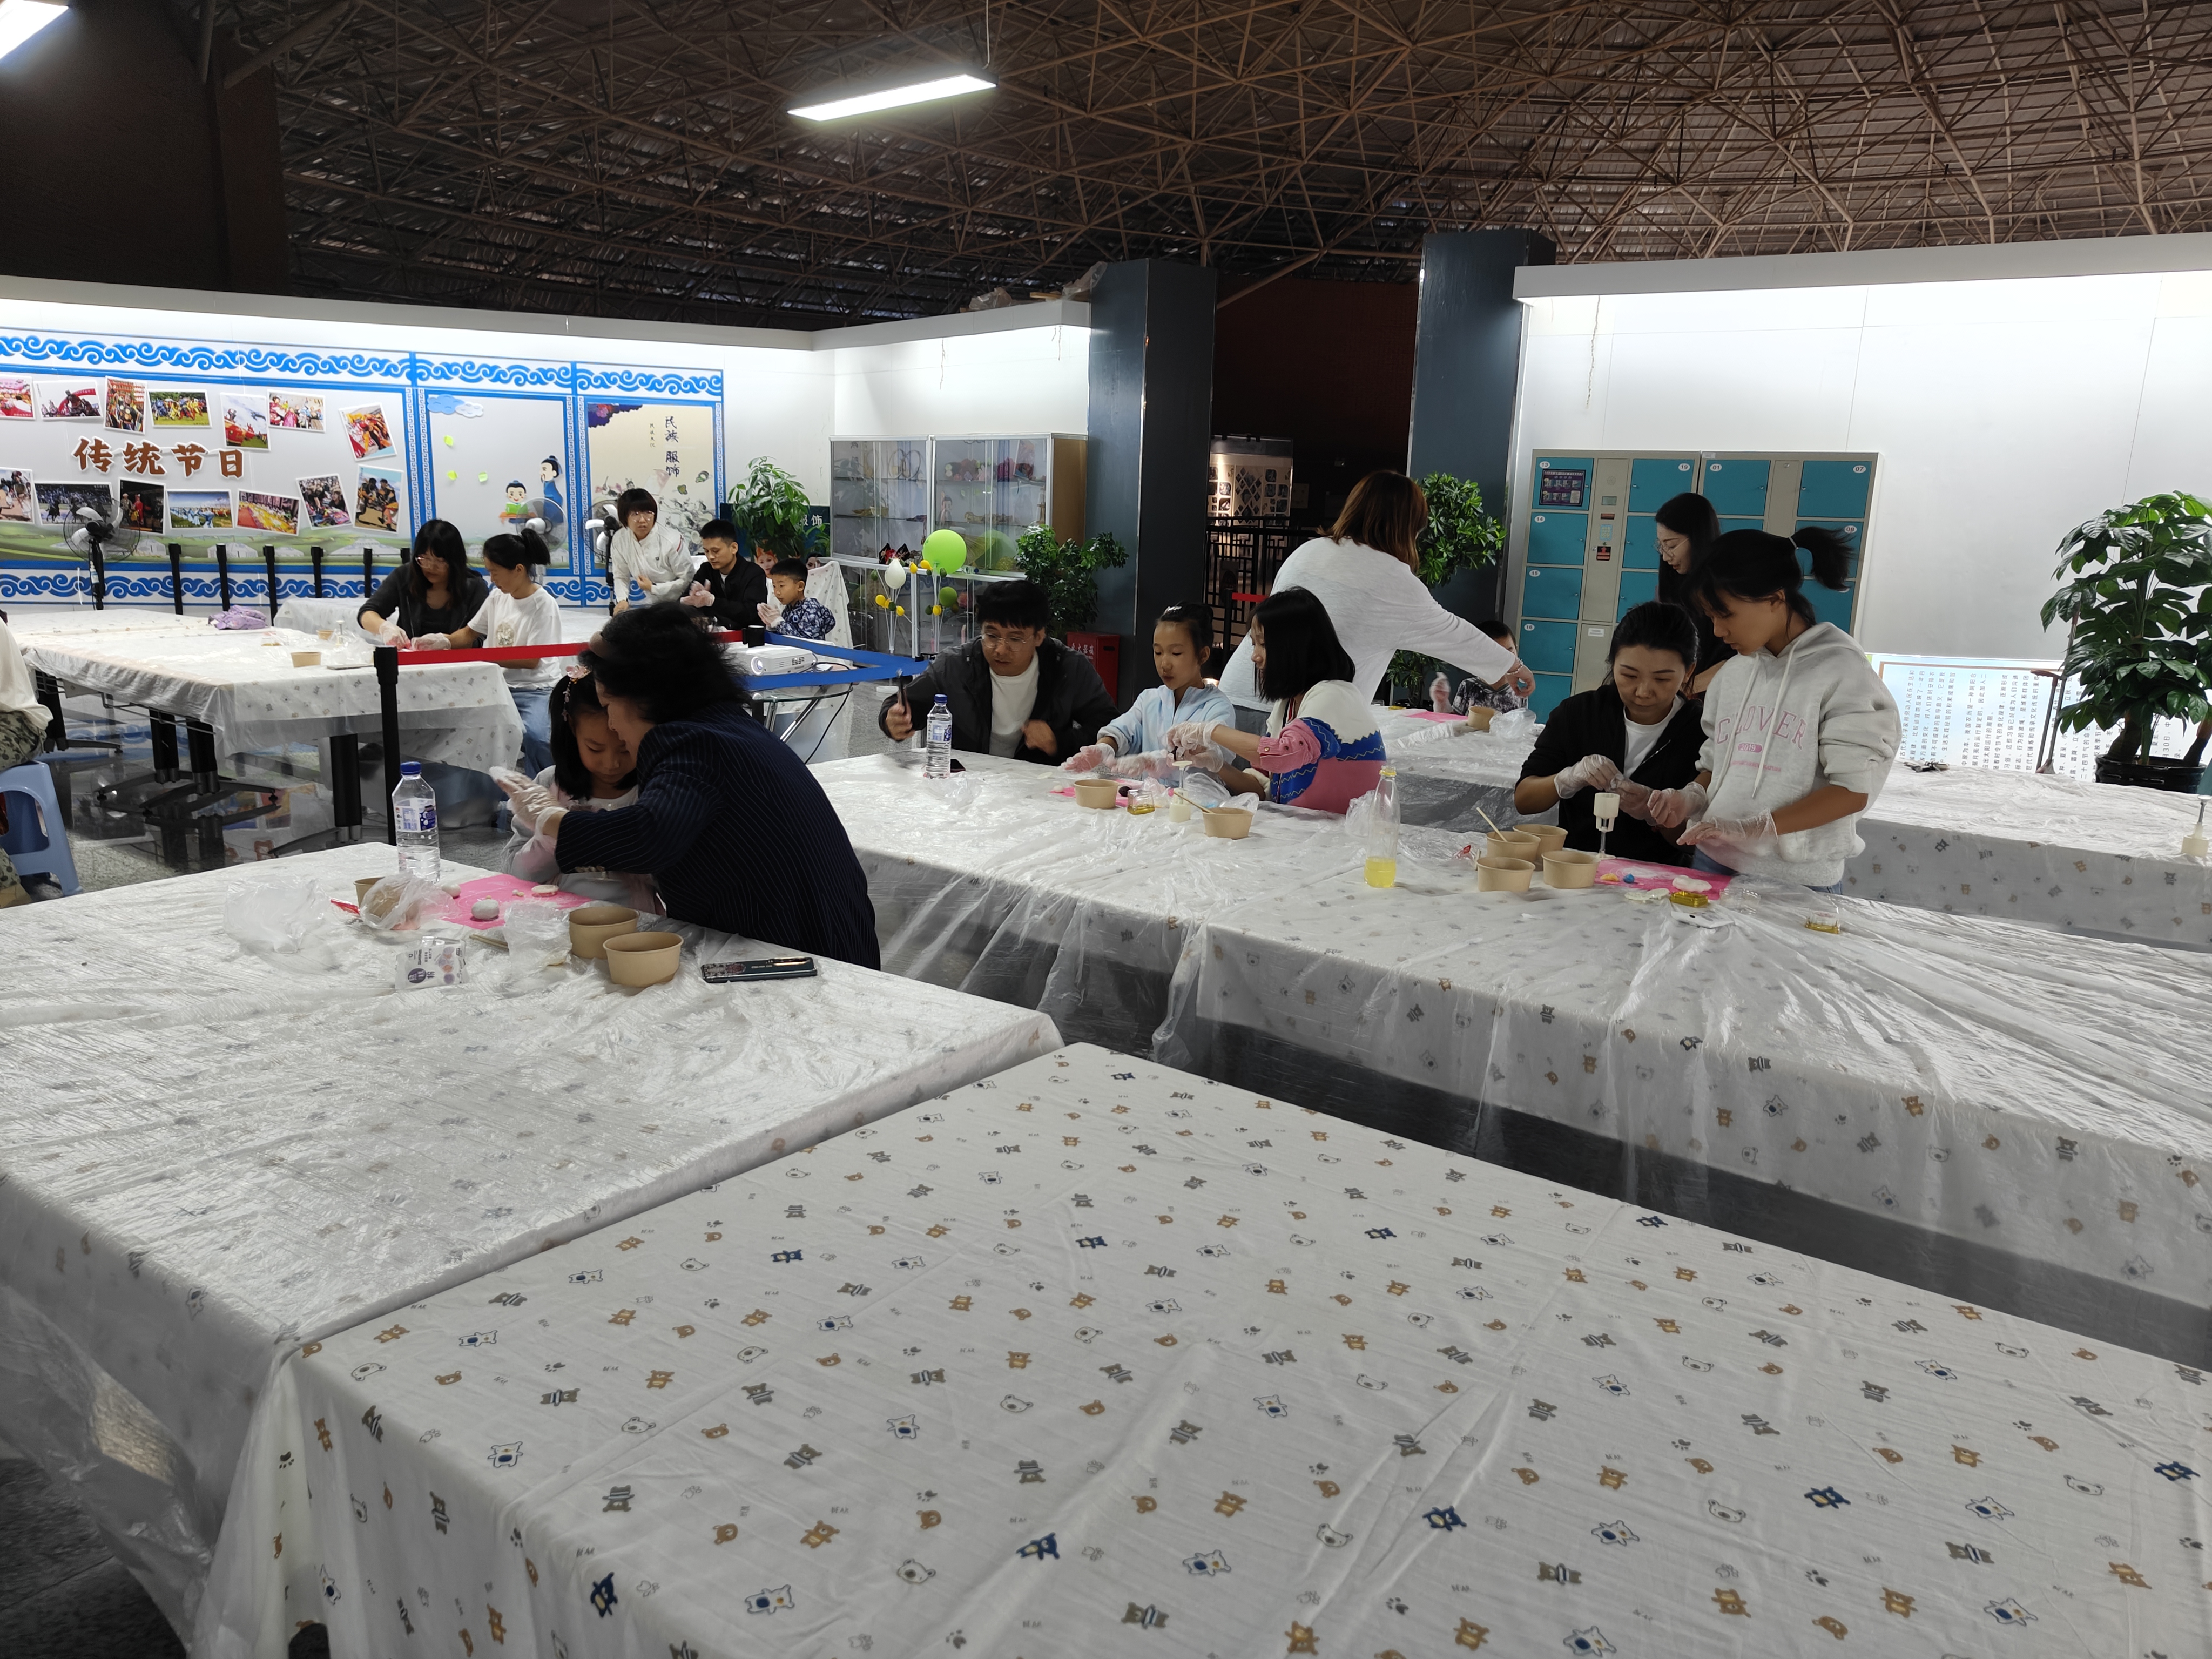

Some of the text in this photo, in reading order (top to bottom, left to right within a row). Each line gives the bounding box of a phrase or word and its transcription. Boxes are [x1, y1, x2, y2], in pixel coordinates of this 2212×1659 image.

[73, 437, 243, 478] 传统节日
[1899, 670, 1915, 760] 古代天文学家和劳动人民在生活和
[1741, 743, 1756, 751] 2019
